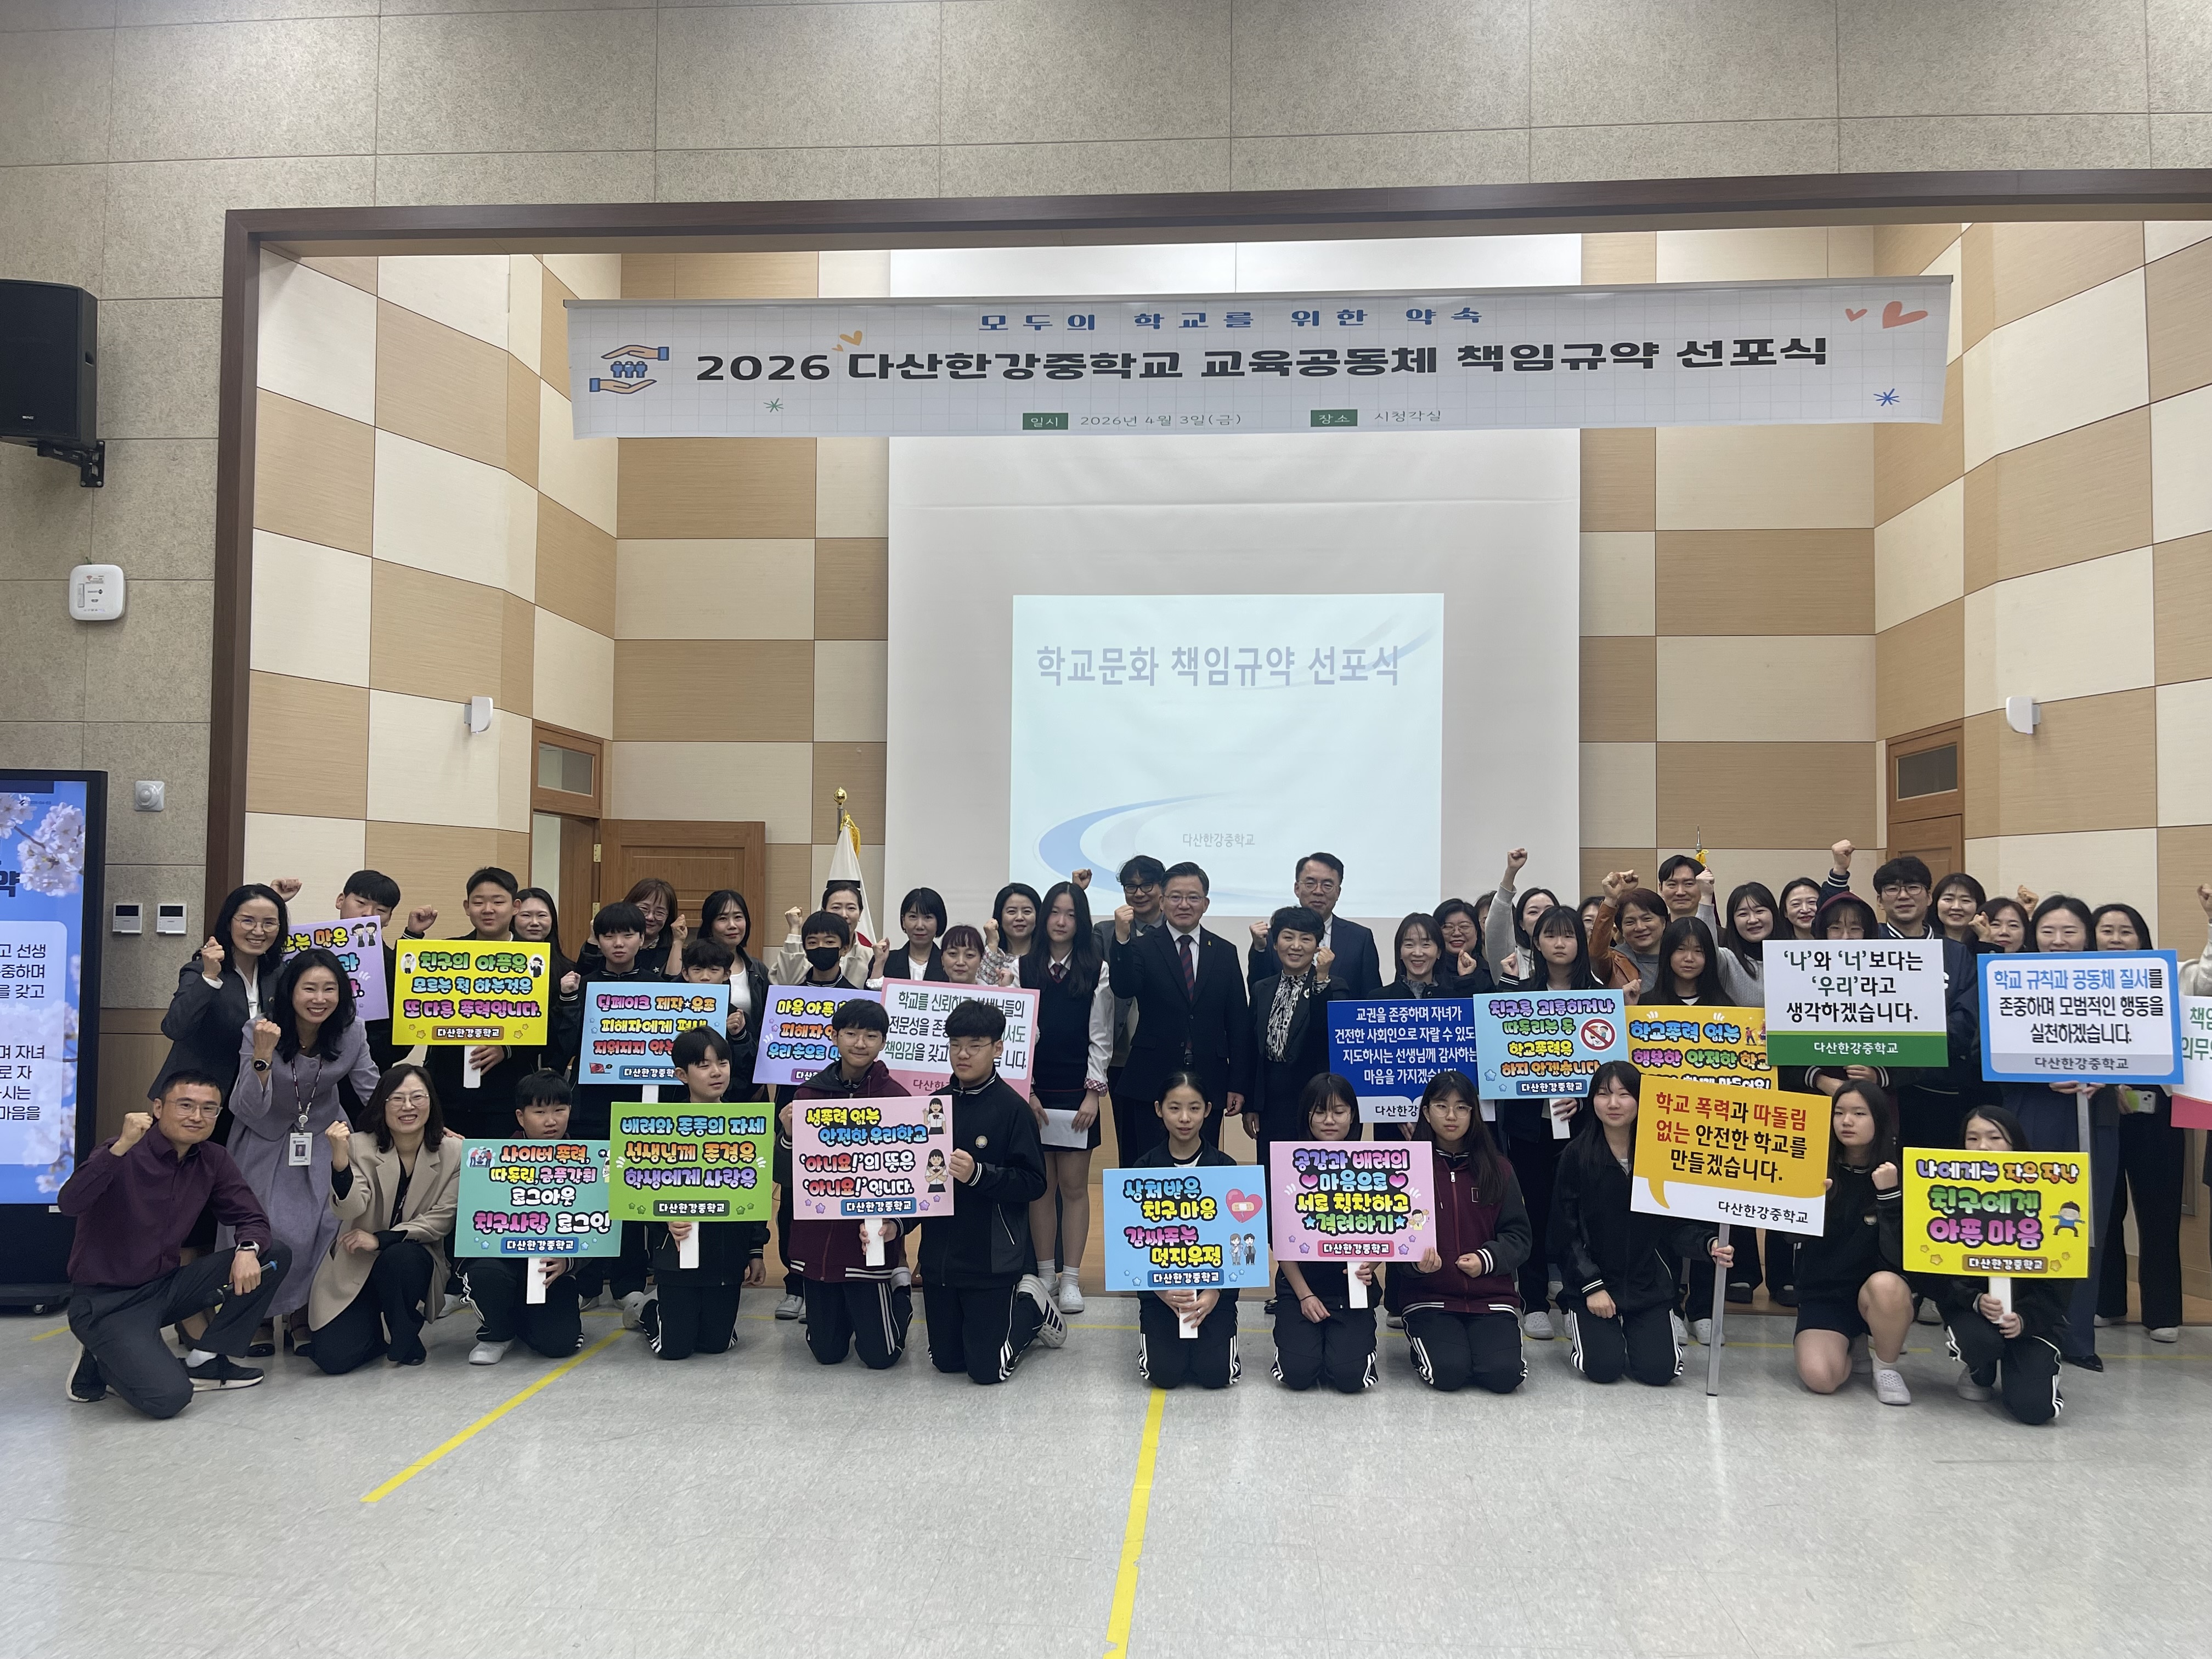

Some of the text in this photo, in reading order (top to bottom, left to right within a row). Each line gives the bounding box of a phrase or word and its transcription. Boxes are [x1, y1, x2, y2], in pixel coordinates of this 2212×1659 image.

[981, 307, 1482, 331] 모두의 학교를 위한 약속
[696, 337, 1828, 381] 2026 다산한강중학교 교육공동체 책임규약 선포식
[1030, 417, 1059, 428] 일시
[1081, 414, 1242, 427] 2026년 4월 3일(금)
[1319, 413, 1351, 424] 장소
[1375, 410, 1441, 423] 시청각실
[1037, 646, 1399, 686] 학교문화 책임규약 선포식
[1183, 833, 1255, 848] 다산한강중학교
[17, 944, 46, 958] 선생
[418, 951, 528, 973] 친구의 아픔을
[1784, 950, 1831, 972] ‘나’와
[0, 964, 45, 978] 중하며
[1994, 968, 2163, 990] 학교 규칙과 공동체 질서를
[15, 984, 44, 998] 갖고
[411, 977, 453, 994] 모르는
[455, 977, 470, 995] 척
[1812, 975, 1897, 997] ‘우리’라고
[403, 999, 542, 1019] 또 다른 폭력입니다.
[776, 998, 805, 1016] 마음
[898, 991, 928, 1011] 학교를
[1489, 998, 1615, 1018] 친구를 괴롭히거나
[1999, 996, 2164, 1017] 존중하며 모범적인 행동을
[1356, 1006, 1462, 1023] 교권을 존중하며 자녀가
[1786, 1002, 1918, 1023] 생각하겠습니다.
[437, 1028, 500, 1039] 다산한강중학교
[600, 1018, 673, 1034] 피해자에게
[779, 1022, 823, 1040] 피해자
[889, 1015, 929, 1036] 전문성을
[1503, 1018, 1576, 1035] 따돌리는 등
[1629, 1020, 1741, 1043] 학교폭력 없는
[2030, 1023, 2132, 1044] 실천하겠습니다.
[1335, 1028, 1365, 1044] 건전한
[1367, 1028, 1418, 1043] 사회인으로
[1419, 1027, 1440, 1042] 자랄
[1442, 1027, 1453, 1042] 수
[15, 1045, 44, 1059] 자녀
[593, 1040, 646, 1055] 지워지지
[767, 1042, 792, 1060] 우리
[792, 1042, 827, 1060] 손으로
[884, 1041, 925, 1062] 책임감을
[928, 1043, 949, 1063] 갖고
[1343, 1047, 1477, 1064] 지도하시는 선생님께 감사하는
[1508, 1040, 1573, 1057] 학교폭력을
[1814, 1042, 1899, 1054] 다산한강중학교
[1632, 1048, 1683, 1068] 행복한
[1685, 1049, 1737, 1070] 안전한
[2034, 1057, 2129, 1070] 다산한강중학교
[17, 1065, 32, 1079] 자
[1364, 1069, 1395, 1085] 마음을
[1500, 1062, 1530, 1077] 하지
[0, 1086, 31, 1100] 시는
[1521, 1082, 1582, 1092] 다산한강중학교
[0, 1105, 41, 1120] 마음을
[806, 1107, 881, 1126] 성폭력 없는
[1375, 1105, 1418, 1116] 다산한강
[1656, 1092, 1807, 1132] 학교 폭력과 따돌림
[620, 1115, 766, 1137] 배려와 존중의 자세
[819, 1124, 929, 1147] 안전한 우리학교
[1656, 1119, 1808, 1160] 없는 안전한 학교를
[500, 1144, 590, 1164] 사이버 폭력,
[625, 1141, 757, 1164] 선생님께 존경을
[883, 1149, 916, 1172] 뜻은
[1293, 1149, 1410, 1172] 공감과 배려의
[1671, 1148, 1783, 1183] 만들겠습니다.
[1916, 1159, 2000, 1182] 나에게는
[2040, 1162, 2079, 1183] 장난
[624, 1167, 757, 1190] 학생에게 사랑을
[1318, 1170, 1389, 1193] 마음으로
[511, 1185, 576, 1206] 로그아웃
[1295, 1192, 1410, 1214] 서로 칭찬하고
[1928, 1185, 2041, 1218] 친구에겐
[659, 1203, 725, 1214] 다산한강중학교
[846, 1200, 911, 1213] 다산한강중학교
[1718, 1201, 1809, 1224] 다산한강중학교
[473, 1210, 612, 1235] 친구사랑 로그인
[1314, 1213, 1396, 1235] 격려하기
[1124, 1224, 1199, 1249] 감싸주는
[1928, 1217, 2044, 1250] 아픈 마음
[507, 1240, 574, 1251] 다산한강중학교
[1323, 1243, 1389, 1254] 다산한강중학교
[1968, 1258, 2043, 1270] 다산한강중학교
[1153, 1273, 1219, 1284] 다산한강중학교
